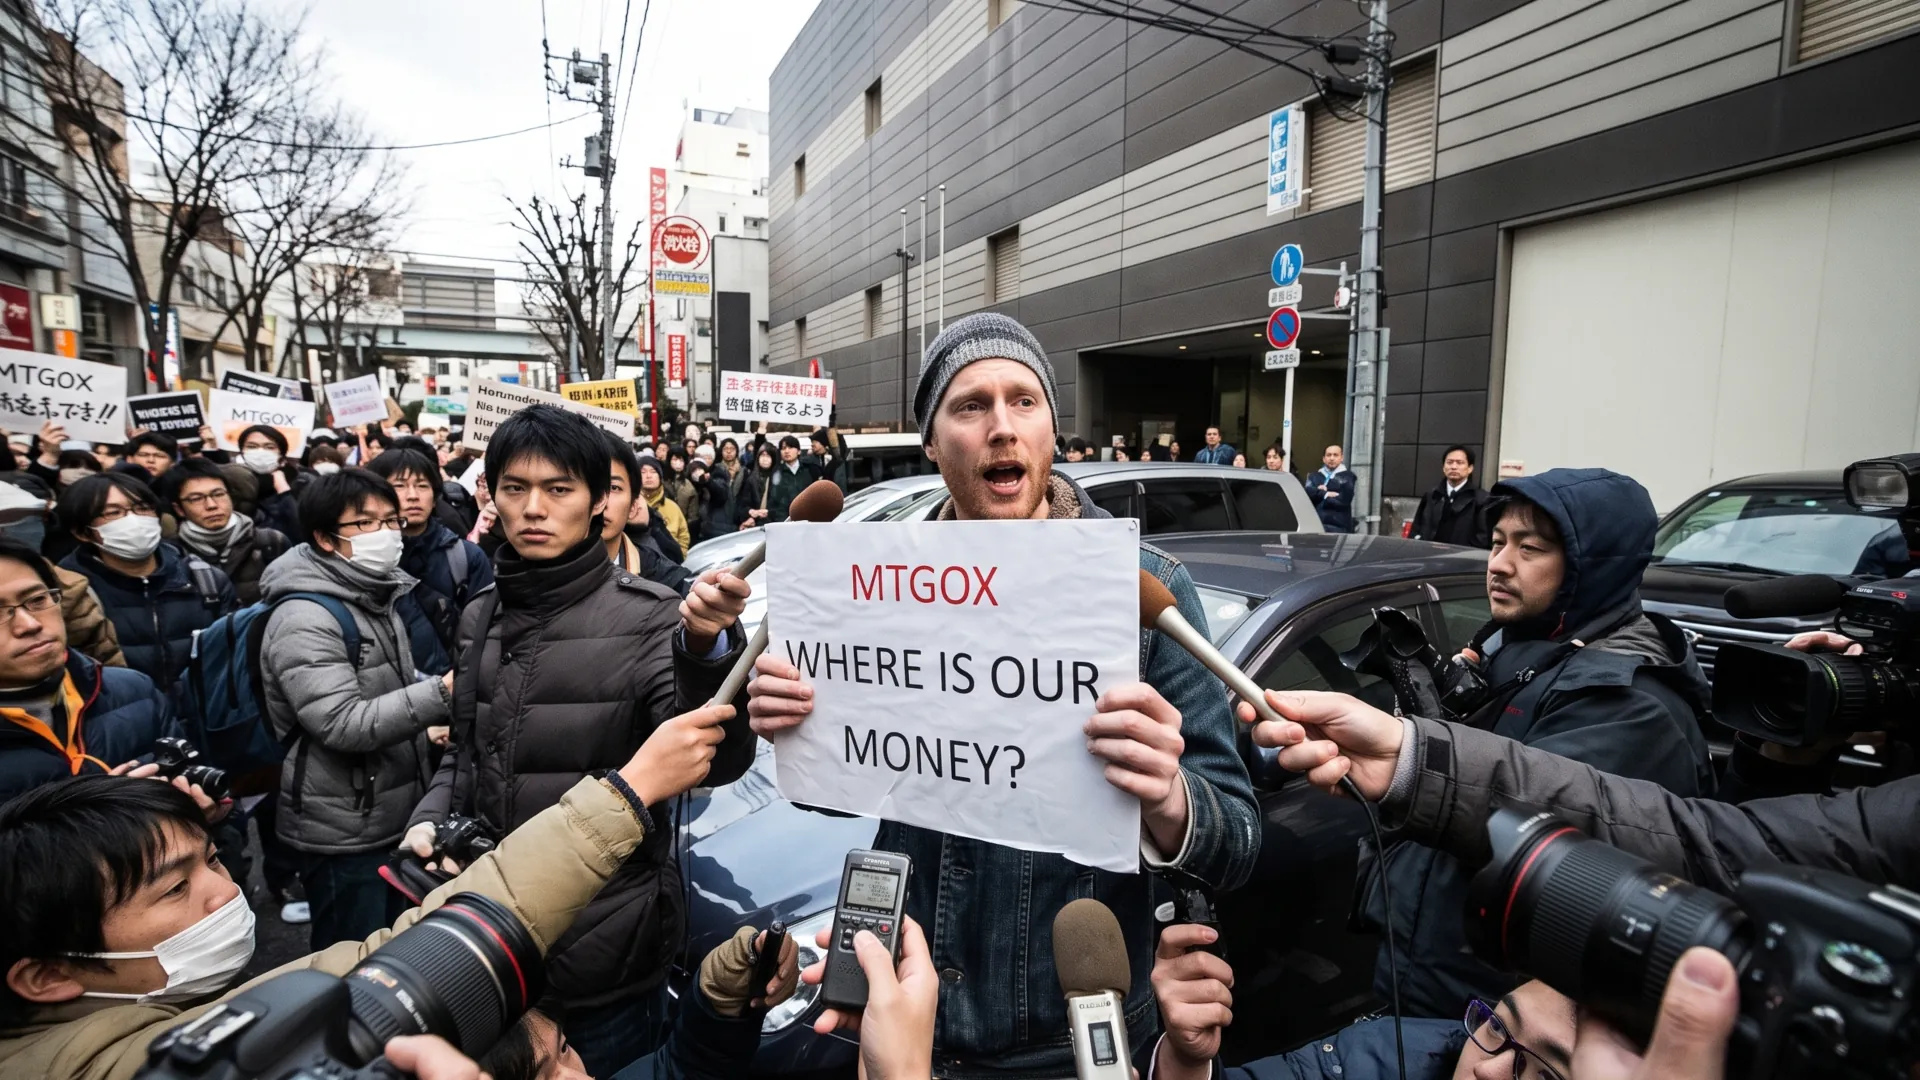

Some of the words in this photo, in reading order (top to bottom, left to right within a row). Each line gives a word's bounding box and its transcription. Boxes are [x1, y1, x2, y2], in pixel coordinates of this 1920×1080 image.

[663, 234, 699, 253] 消火栓
[0, 363, 94, 392] MTGOX
[232, 408, 296, 426] MTGOX
[852, 564, 998, 606] MTGOX
[785, 640, 924, 690] WHERE
[940, 651, 975, 694] IS
[991, 655, 1100, 705] OUR
[844, 725, 1026, 789] MONEY?
